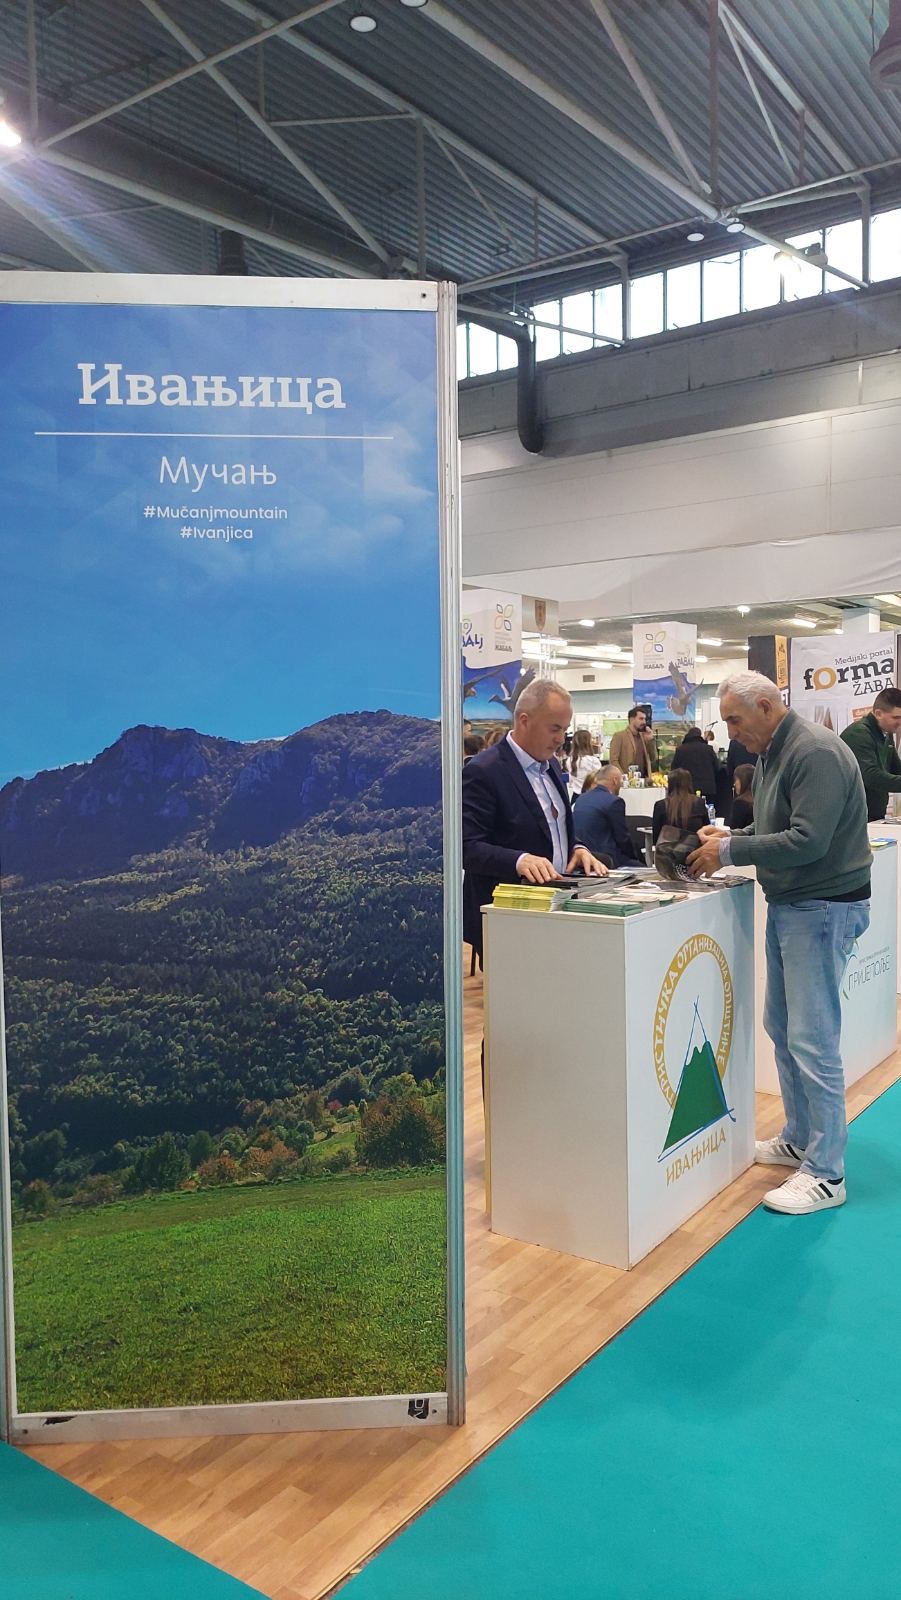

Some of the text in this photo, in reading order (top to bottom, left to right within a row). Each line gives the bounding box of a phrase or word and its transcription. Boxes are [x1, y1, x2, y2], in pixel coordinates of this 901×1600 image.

[77, 362, 347, 415] Ивањица
[159, 455, 277, 492] Мучањ
[143, 505, 288, 522] #Mučanjmountain
[179, 526, 254, 542] #Ivanjica
[835, 647, 893, 665] Medijski portal
[803, 657, 894, 691] forma
[654, 936, 732, 1104] ТУРИСТИЧКА ОРГАНИЗАЦИЈА ОПШТИНЕ
[665, 1127, 727, 1188] ИВАЊИЦА
